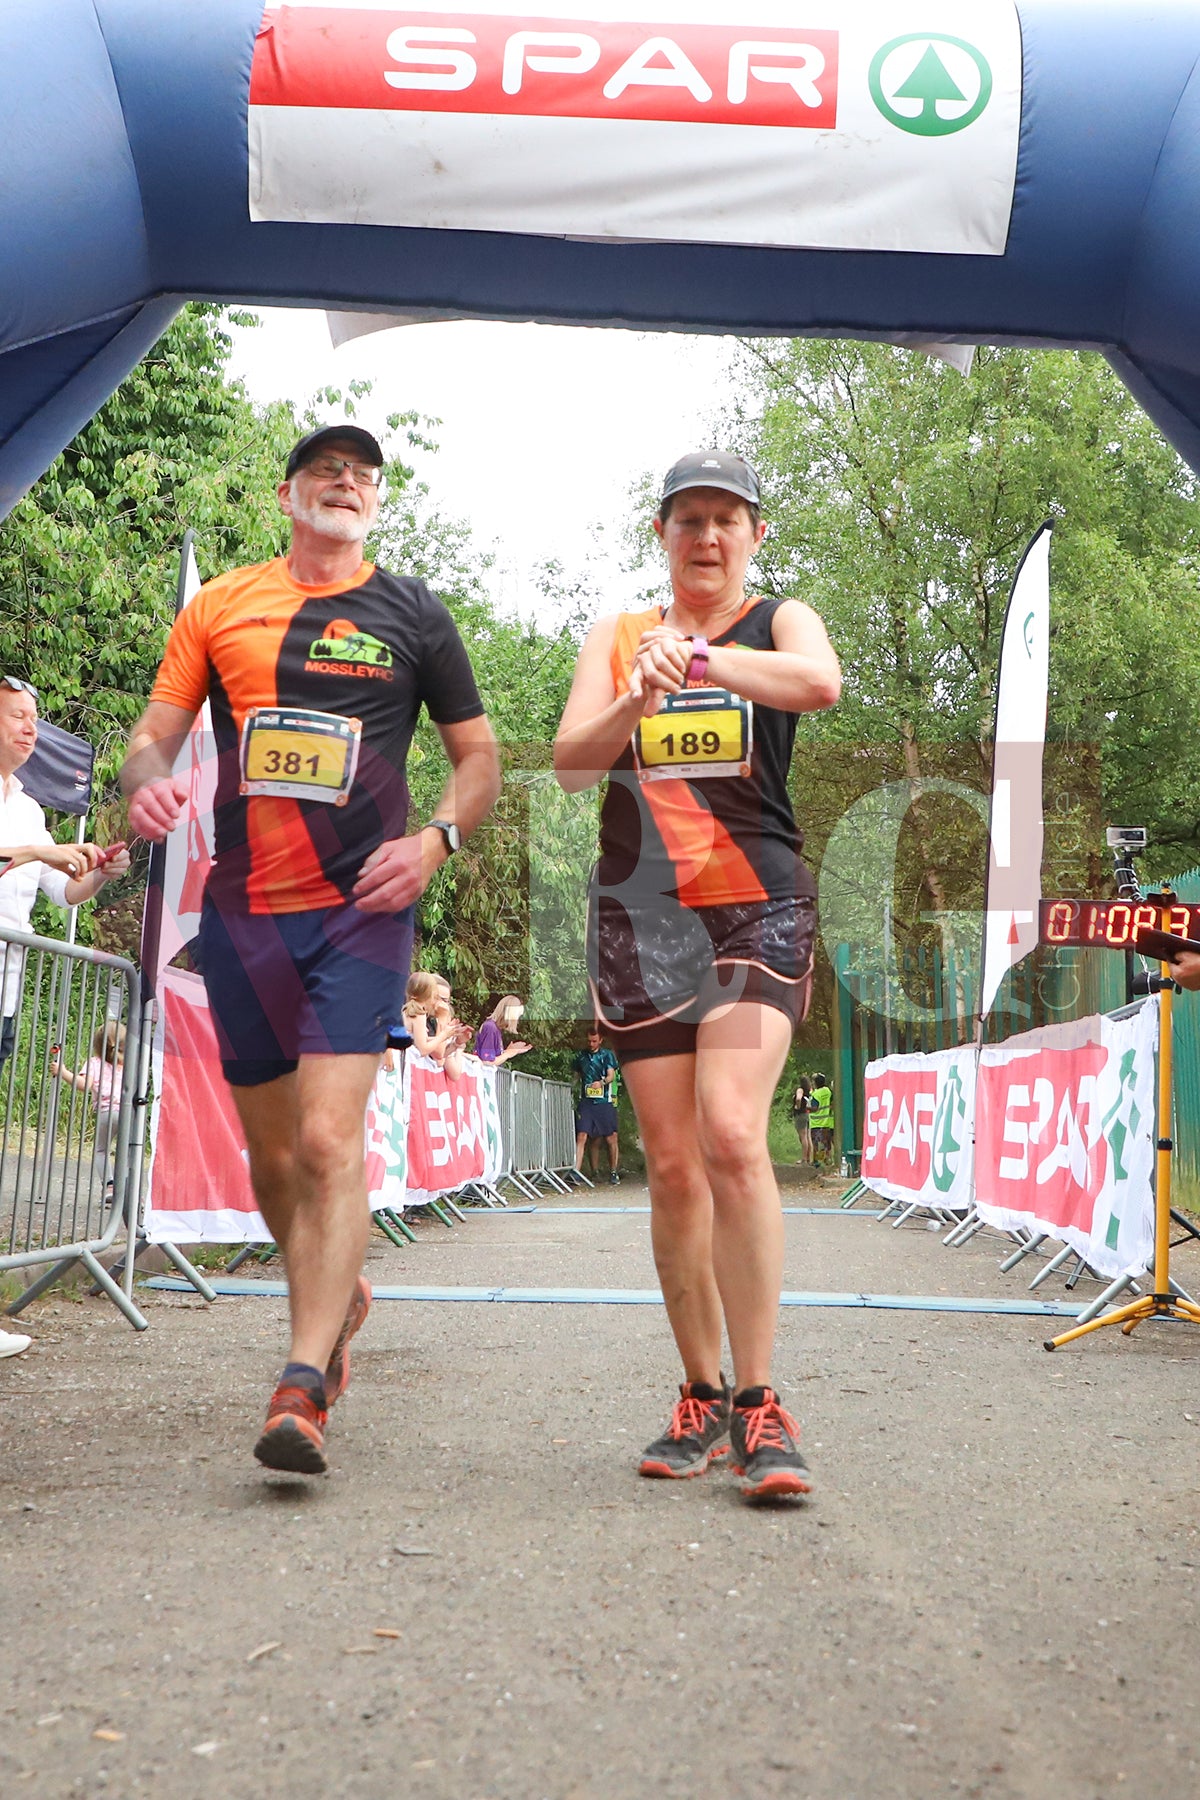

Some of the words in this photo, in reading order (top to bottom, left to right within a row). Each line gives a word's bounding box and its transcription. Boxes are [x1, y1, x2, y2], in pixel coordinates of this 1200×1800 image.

[383, 26, 826, 108] SPAR
[660, 731, 720, 756] 189
[264, 750, 320, 777] 381
